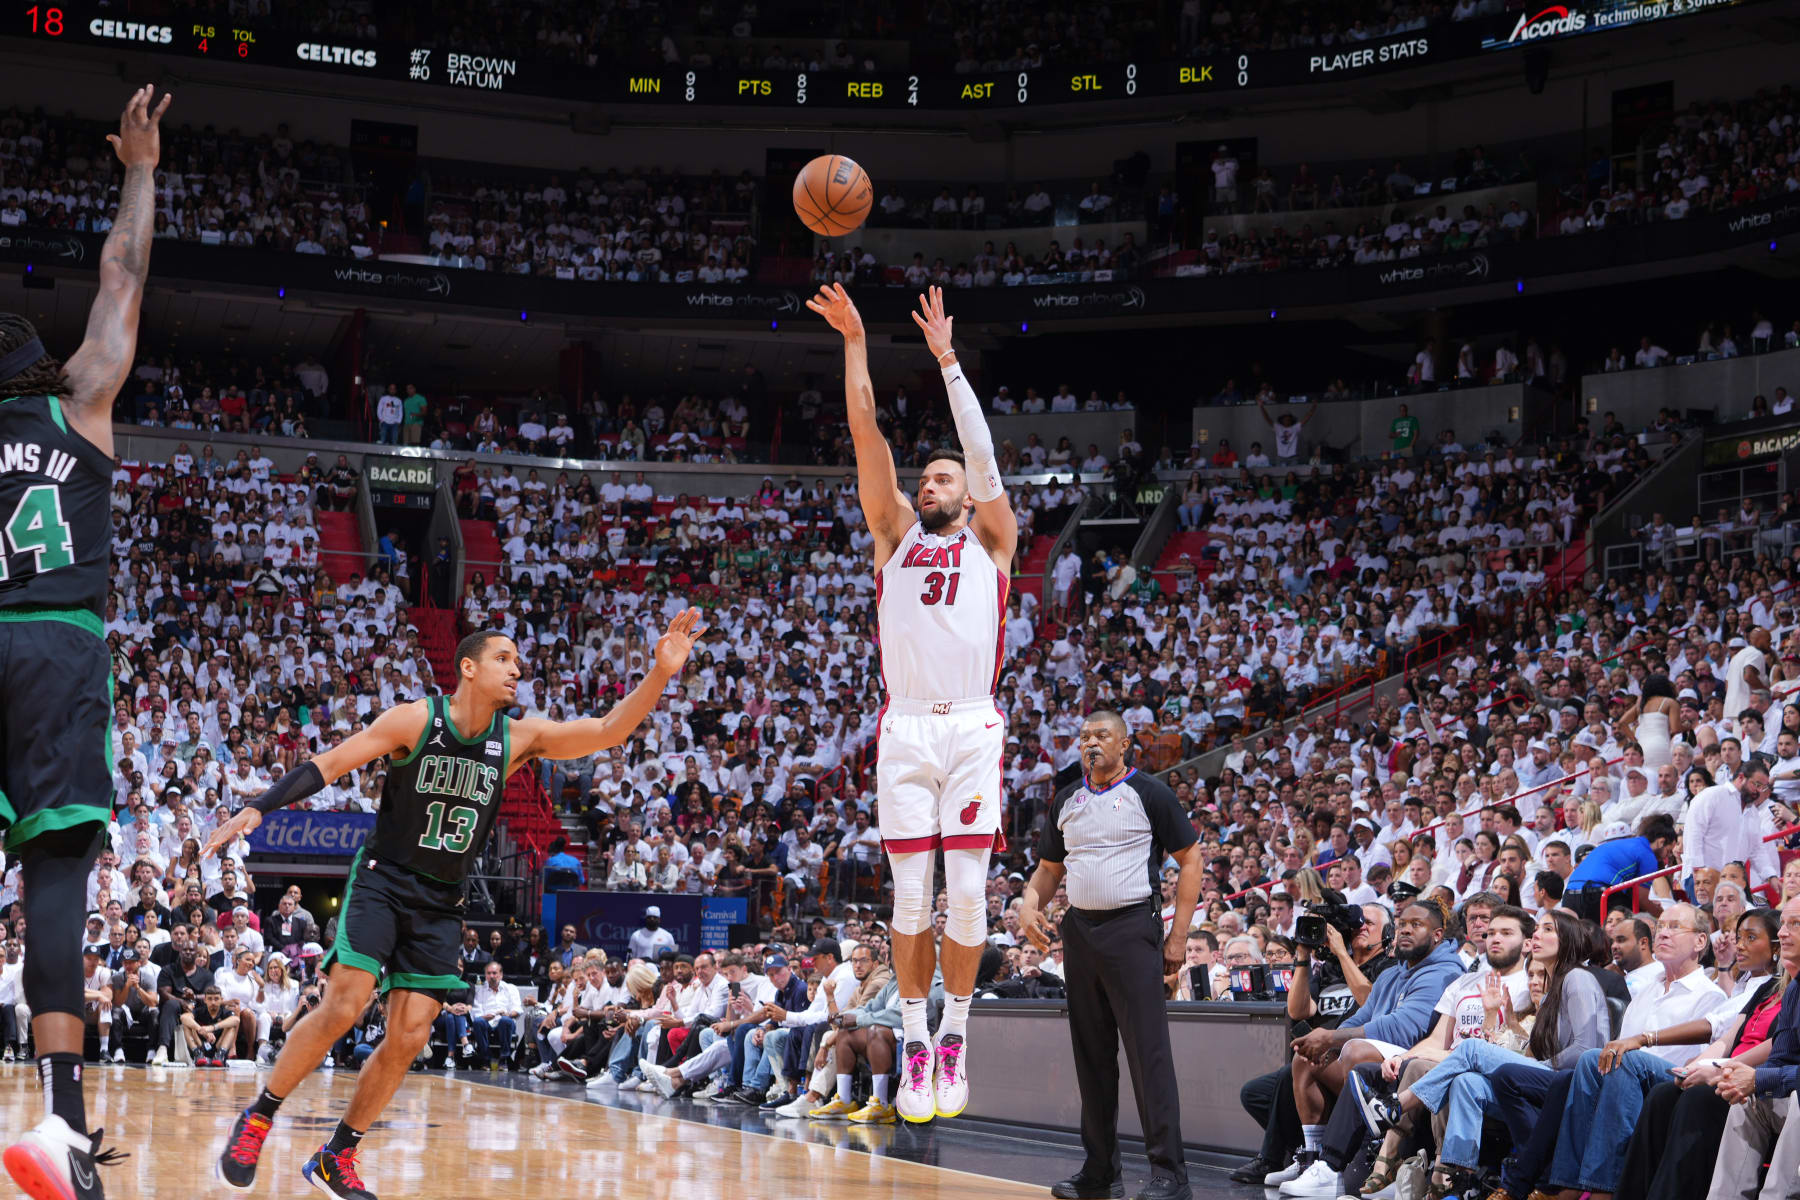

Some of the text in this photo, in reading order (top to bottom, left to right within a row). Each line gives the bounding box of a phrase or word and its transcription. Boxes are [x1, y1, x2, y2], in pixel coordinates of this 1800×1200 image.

[26, 5, 64, 35] 18
[1508, 12, 1586, 42] Acordis
[1594, 3, 1668, 27] Technology
[89, 18, 172, 43] CELTICS
[193, 24, 215, 38] FLS
[232, 29, 256, 43] TOL
[198, 39, 208, 53] 4
[238, 43, 248, 58] 6
[297, 43, 376, 67] CELTICS
[410, 49, 430, 64] #7
[1238, 55, 1248, 70] 0
[1310, 39, 1428, 72] PLAYER STATS
[447, 53, 515, 75] BROWN
[1126, 64, 1136, 79] 0
[410, 65, 430, 80] #0
[447, 68, 502, 89] TATUM
[686, 71, 695, 86] 9
[1018, 72, 1027, 87] 0
[1179, 66, 1213, 83] BLK
[1238, 71, 1248, 86] 0
[630, 77, 660, 93] MIN
[738, 80, 772, 95] PTS
[797, 74, 807, 88] 8
[908, 76, 918, 90] 2
[1071, 75, 1102, 91] STL
[1126, 80, 1136, 95] 0
[685, 87, 695, 101] 8
[797, 89, 806, 104] 5
[847, 82, 883, 98] REB
[961, 82, 994, 99] AST
[1018, 88, 1027, 103] 0
[908, 91, 918, 106] 4
[1728, 211, 1772, 232] white
[334, 267, 383, 284] white
[1380, 266, 1424, 284] white
[687, 292, 733, 306] white
[1033, 293, 1080, 307] white
[44, 449, 78, 482] III
[370, 466, 433, 485] BACARDÍ
[0, 484, 75, 581] 4
[901, 537, 965, 568] HEAT
[921, 572, 960, 605] 31
[434, 717, 442, 727] 6
[416, 755, 498, 805] CELTICS
[418, 801, 478, 853] 13
